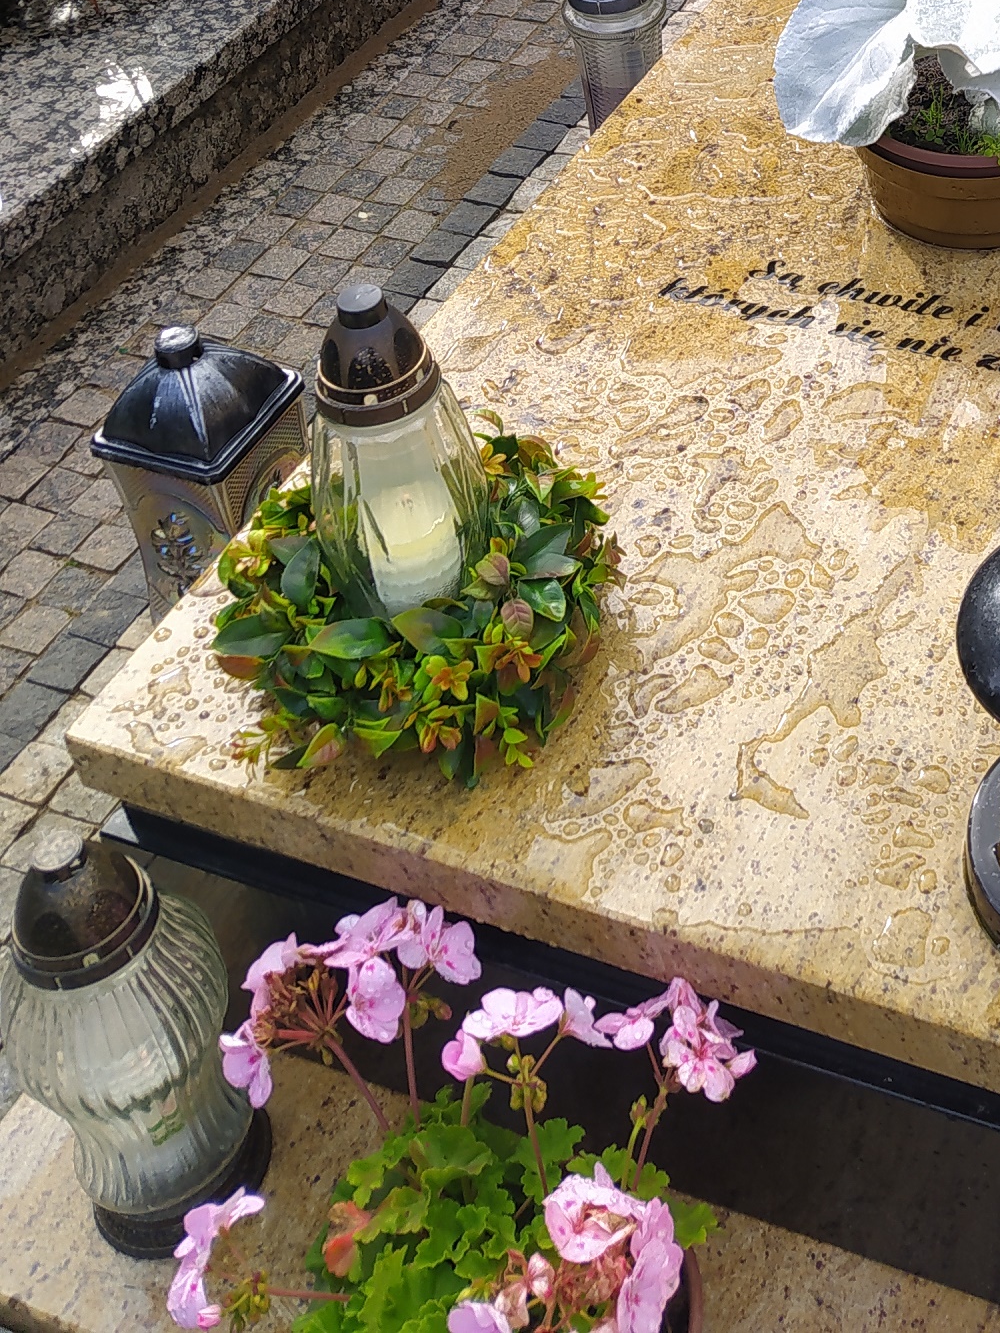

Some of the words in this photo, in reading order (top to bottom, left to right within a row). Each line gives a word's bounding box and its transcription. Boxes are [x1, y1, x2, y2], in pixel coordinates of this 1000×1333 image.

[657, 276, 817, 330] których
[827, 319, 886, 353] się
[895, 334, 964, 361] nie
[749, 259, 806, 294] Są
[816, 277, 955, 319] chwile
[964, 305, 991, 329] i
